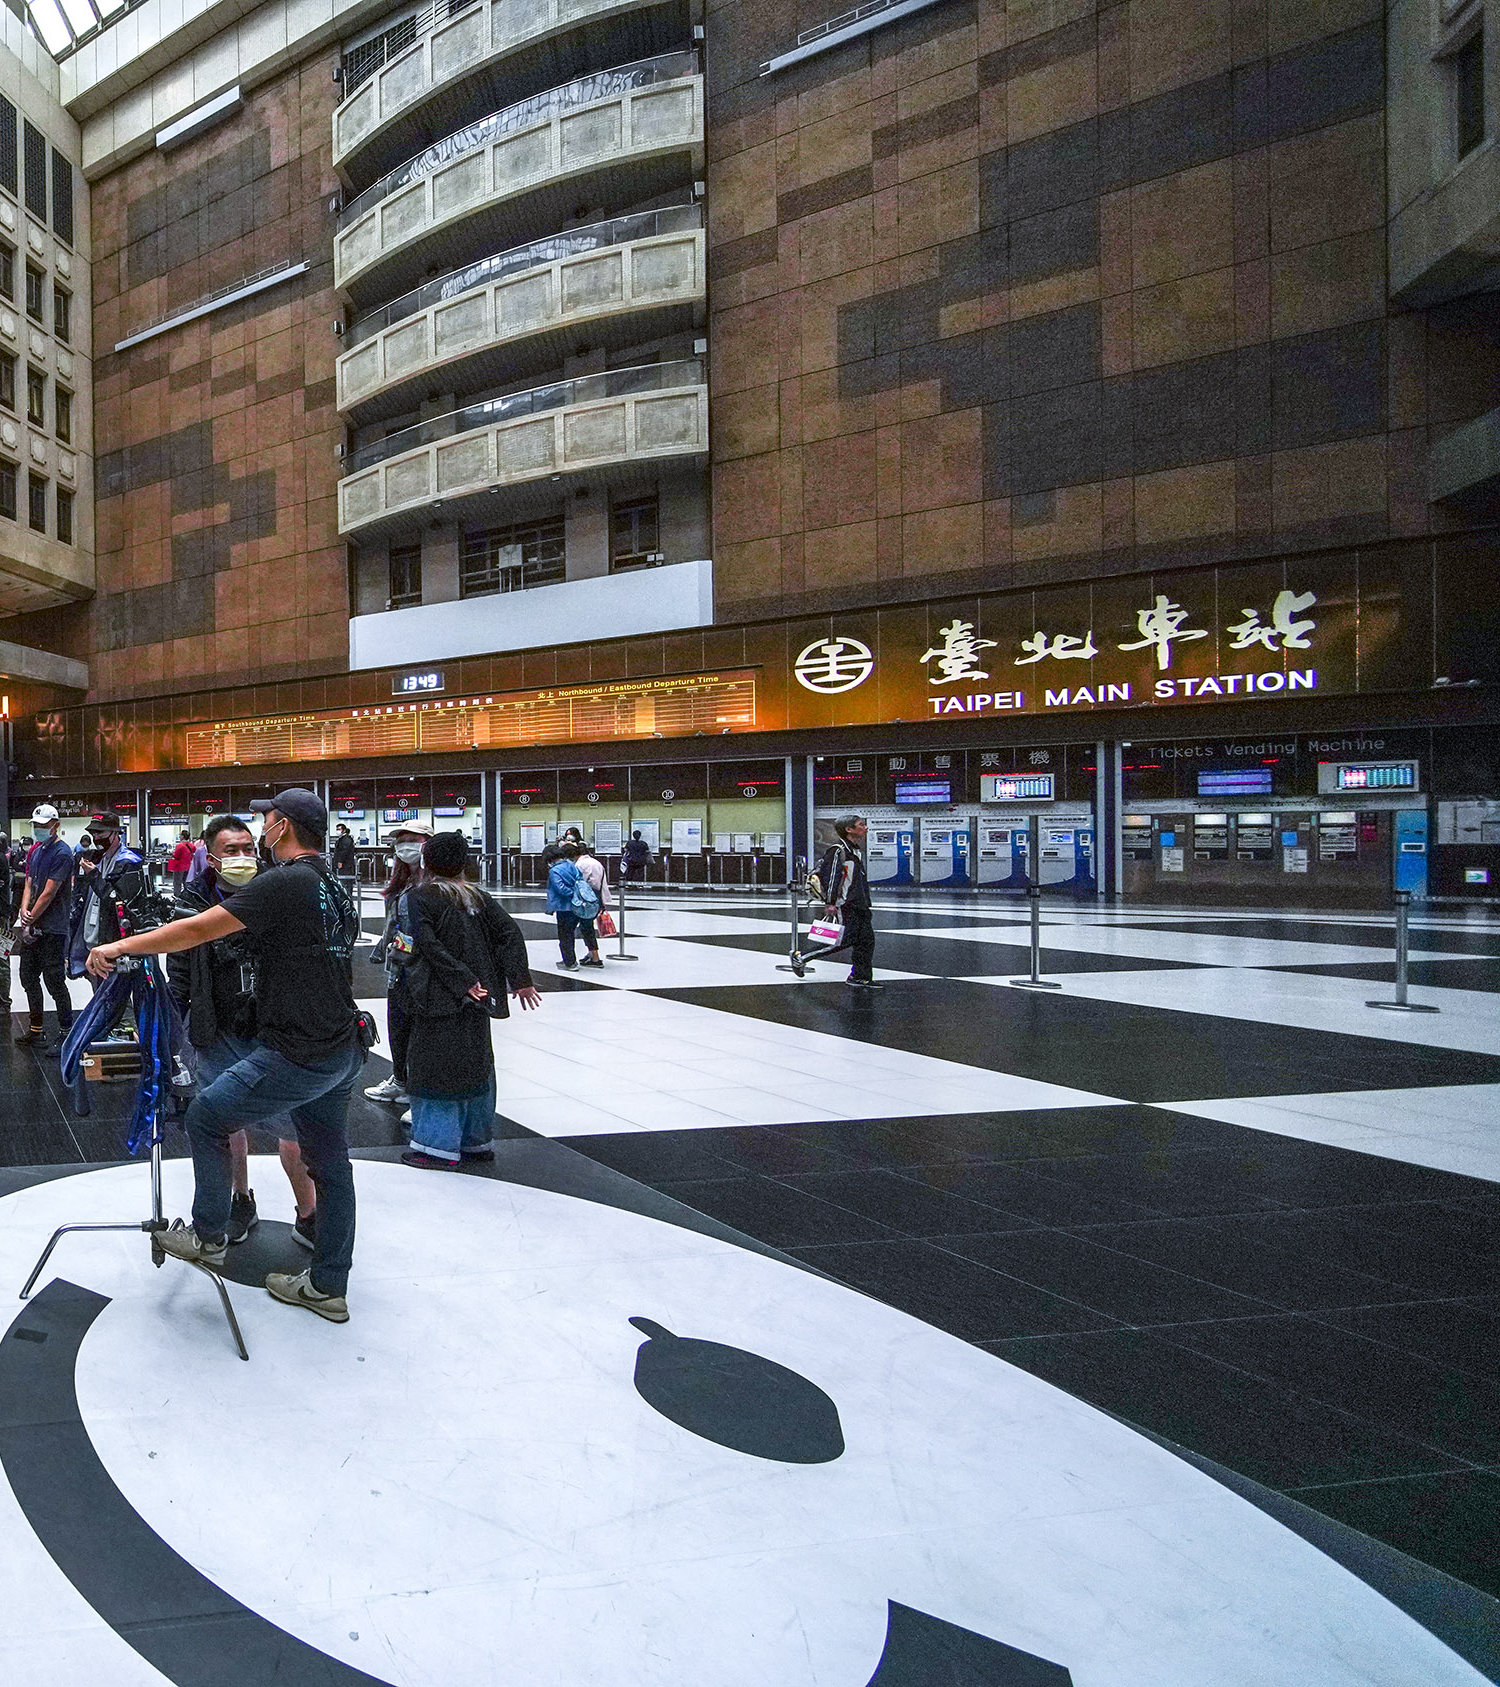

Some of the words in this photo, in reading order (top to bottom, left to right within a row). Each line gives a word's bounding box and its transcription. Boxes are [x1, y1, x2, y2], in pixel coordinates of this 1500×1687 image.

[920, 590, 1317, 684] 臺北車站
[558, 686, 603, 697] Northbound
[609, 682, 652, 692] Eastbound
[654, 678, 695, 688] Departure
[928, 690, 1023, 714] TAIPEI
[1044, 682, 1129, 707] MAIN
[1154, 669, 1315, 698] STATION
[227, 720, 263, 728] Southbound
[265, 717, 297, 725] Departure
[1150, 745, 1213, 759] Tickets
[1225, 742, 1296, 757] Vending
[1309, 739, 1385, 752] Machine
[846, 750, 1050, 773] 自動售票機
